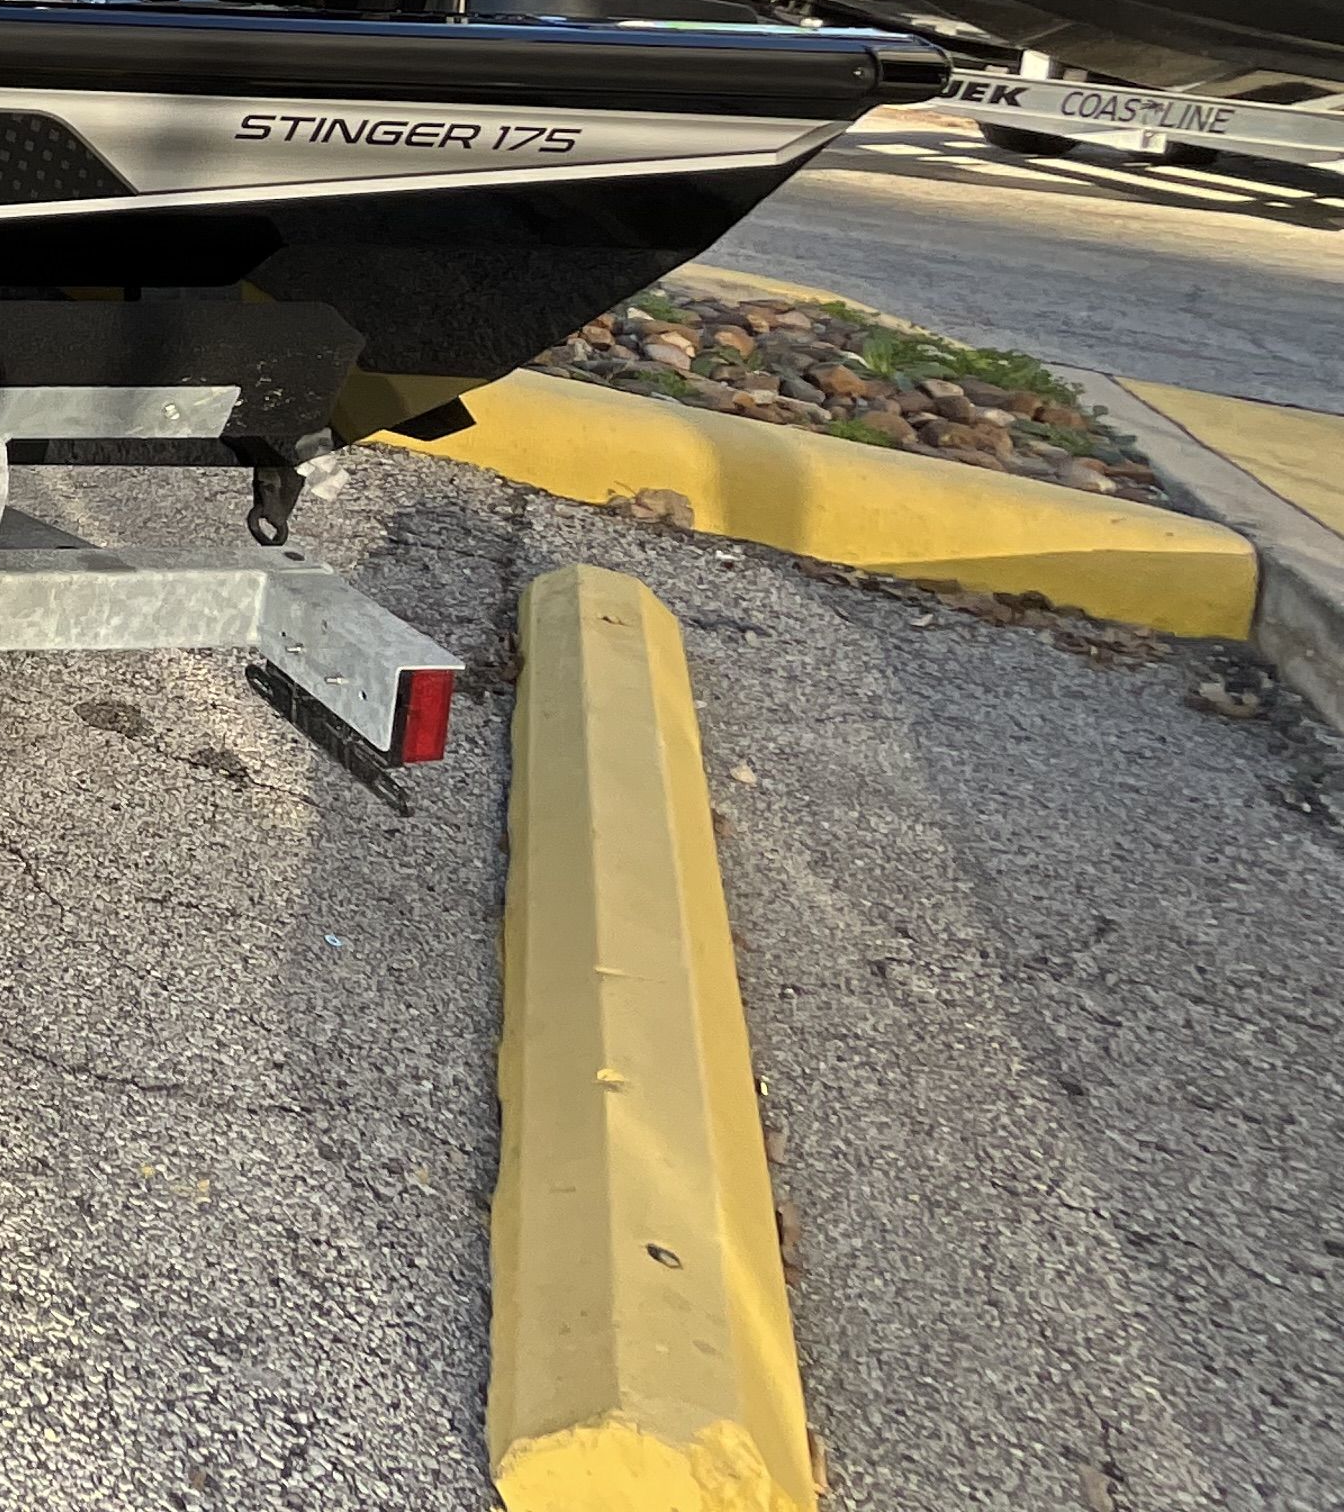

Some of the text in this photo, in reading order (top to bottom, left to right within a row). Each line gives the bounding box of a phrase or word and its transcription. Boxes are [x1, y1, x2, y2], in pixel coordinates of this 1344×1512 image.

[934, 79, 1031, 108] JEK
[234, 114, 583, 153] STINGER 175
